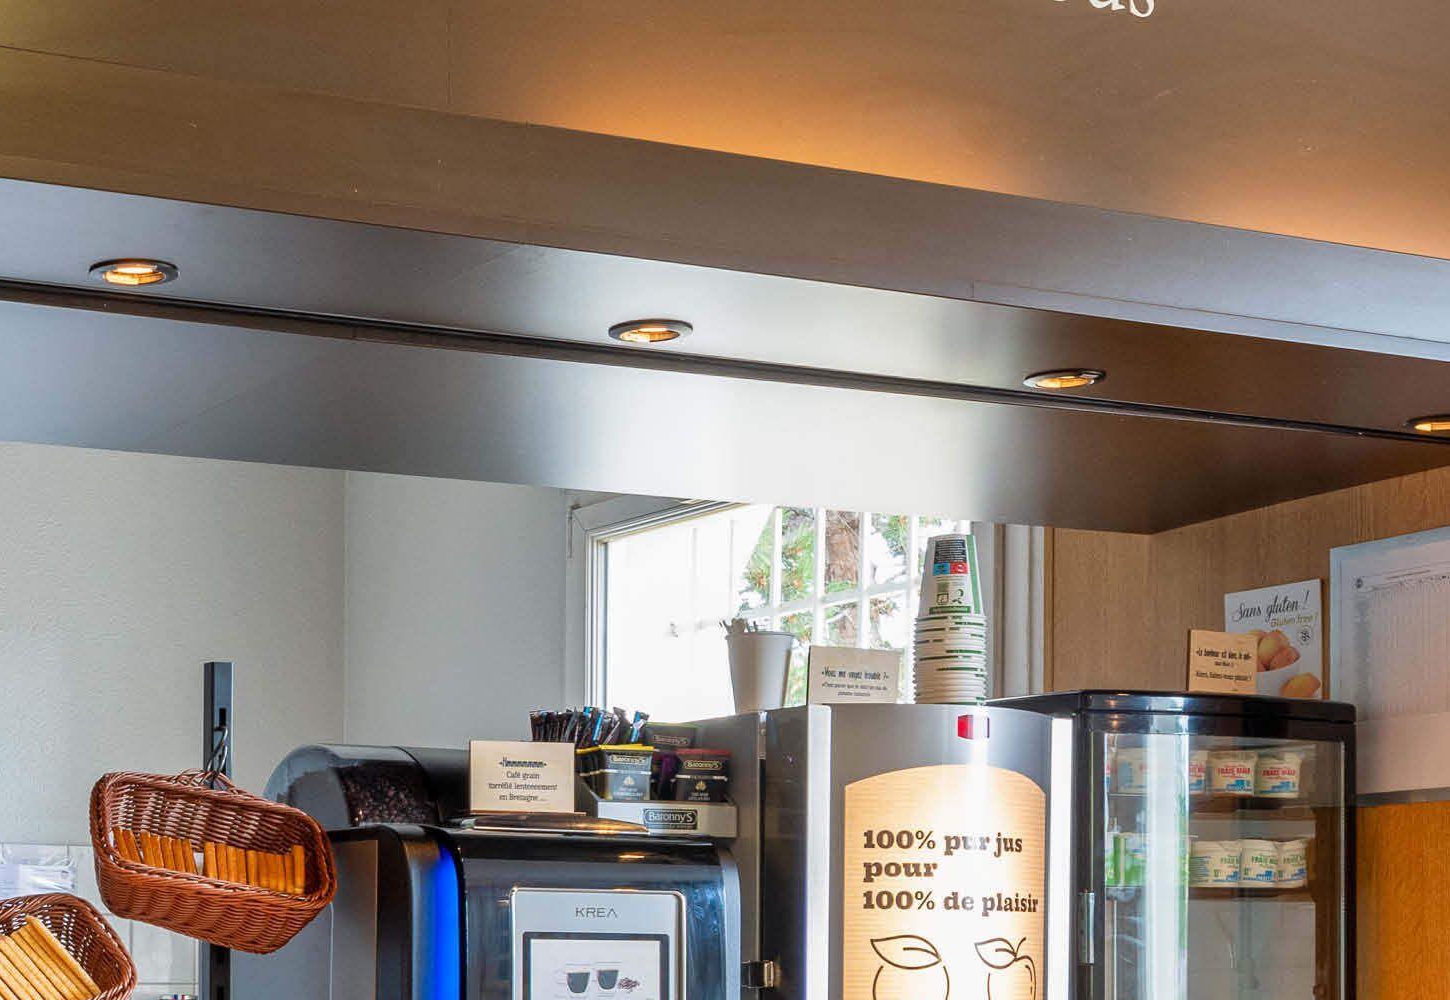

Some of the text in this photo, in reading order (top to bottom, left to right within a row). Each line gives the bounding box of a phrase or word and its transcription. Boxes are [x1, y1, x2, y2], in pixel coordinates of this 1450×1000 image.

[1232, 602, 1261, 622] Sans
[1265, 594, 1298, 622] gluten
[863, 829, 1023, 858] 100% pur jus
[863, 860, 938, 883] pour
[575, 907, 618, 918] KREA
[863, 890, 1039, 917] 100% de plaisir
